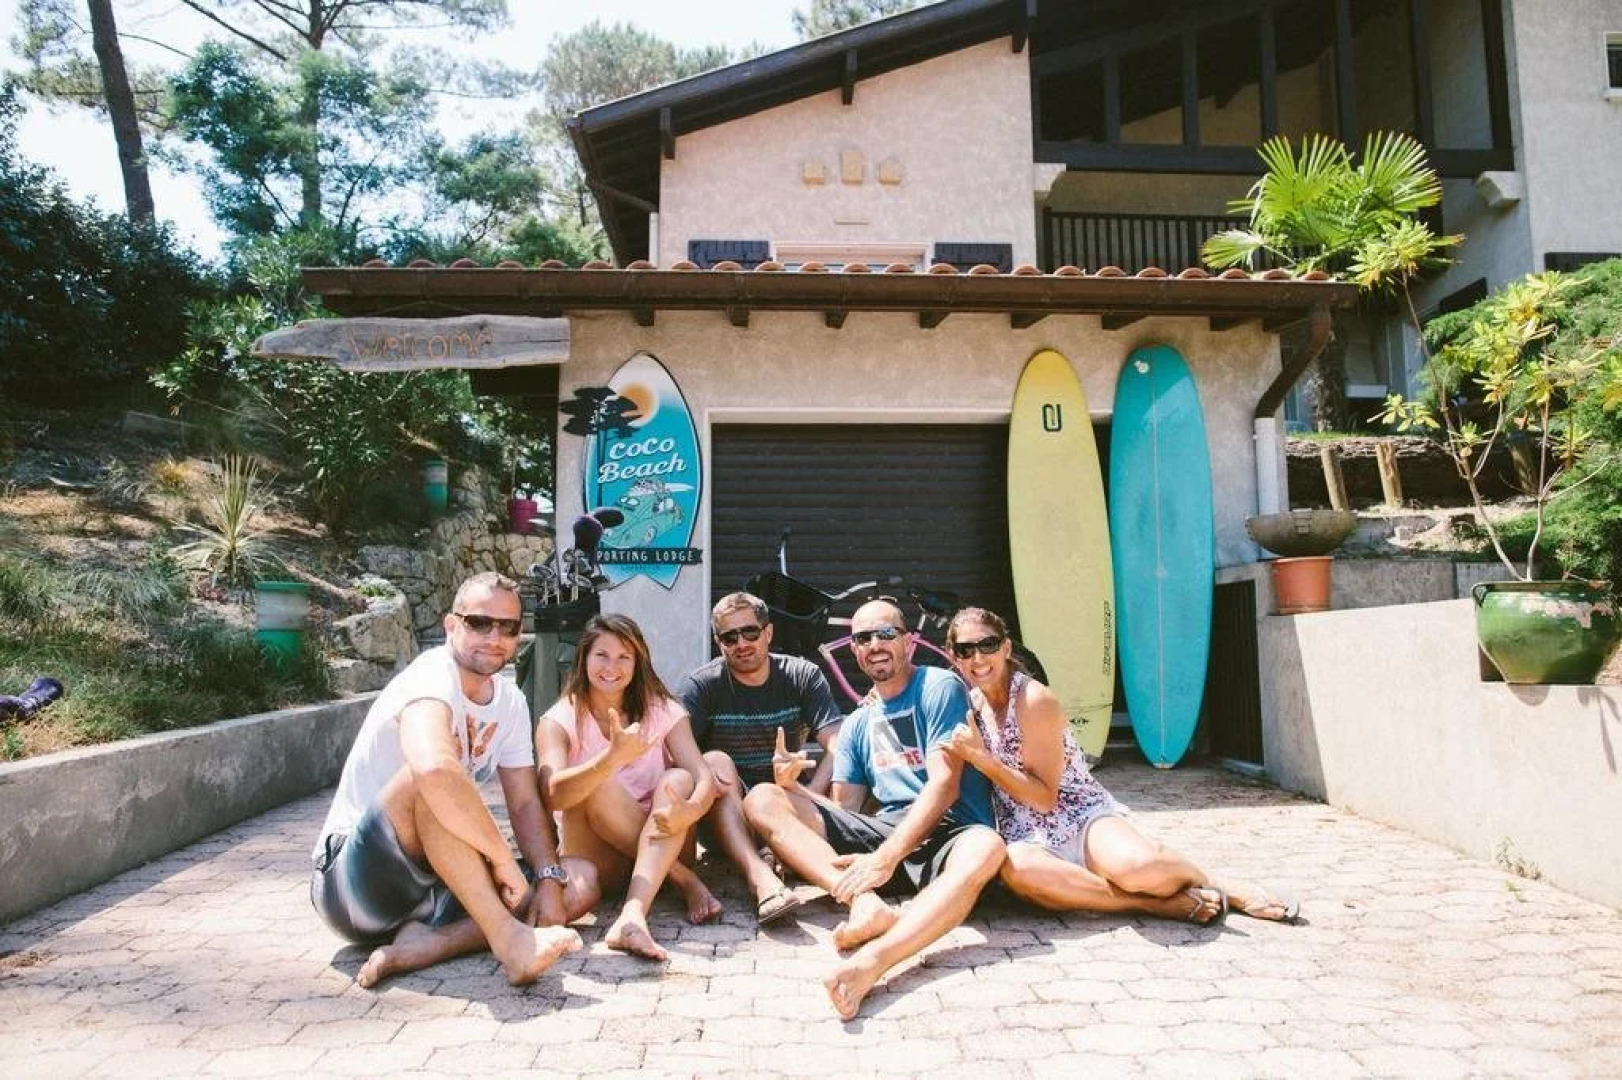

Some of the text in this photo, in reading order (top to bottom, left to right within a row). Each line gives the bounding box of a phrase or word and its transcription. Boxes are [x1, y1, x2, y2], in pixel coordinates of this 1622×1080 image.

[597, 452, 687, 484] Beach
[596, 550, 695, 562] PORTING LODGE
